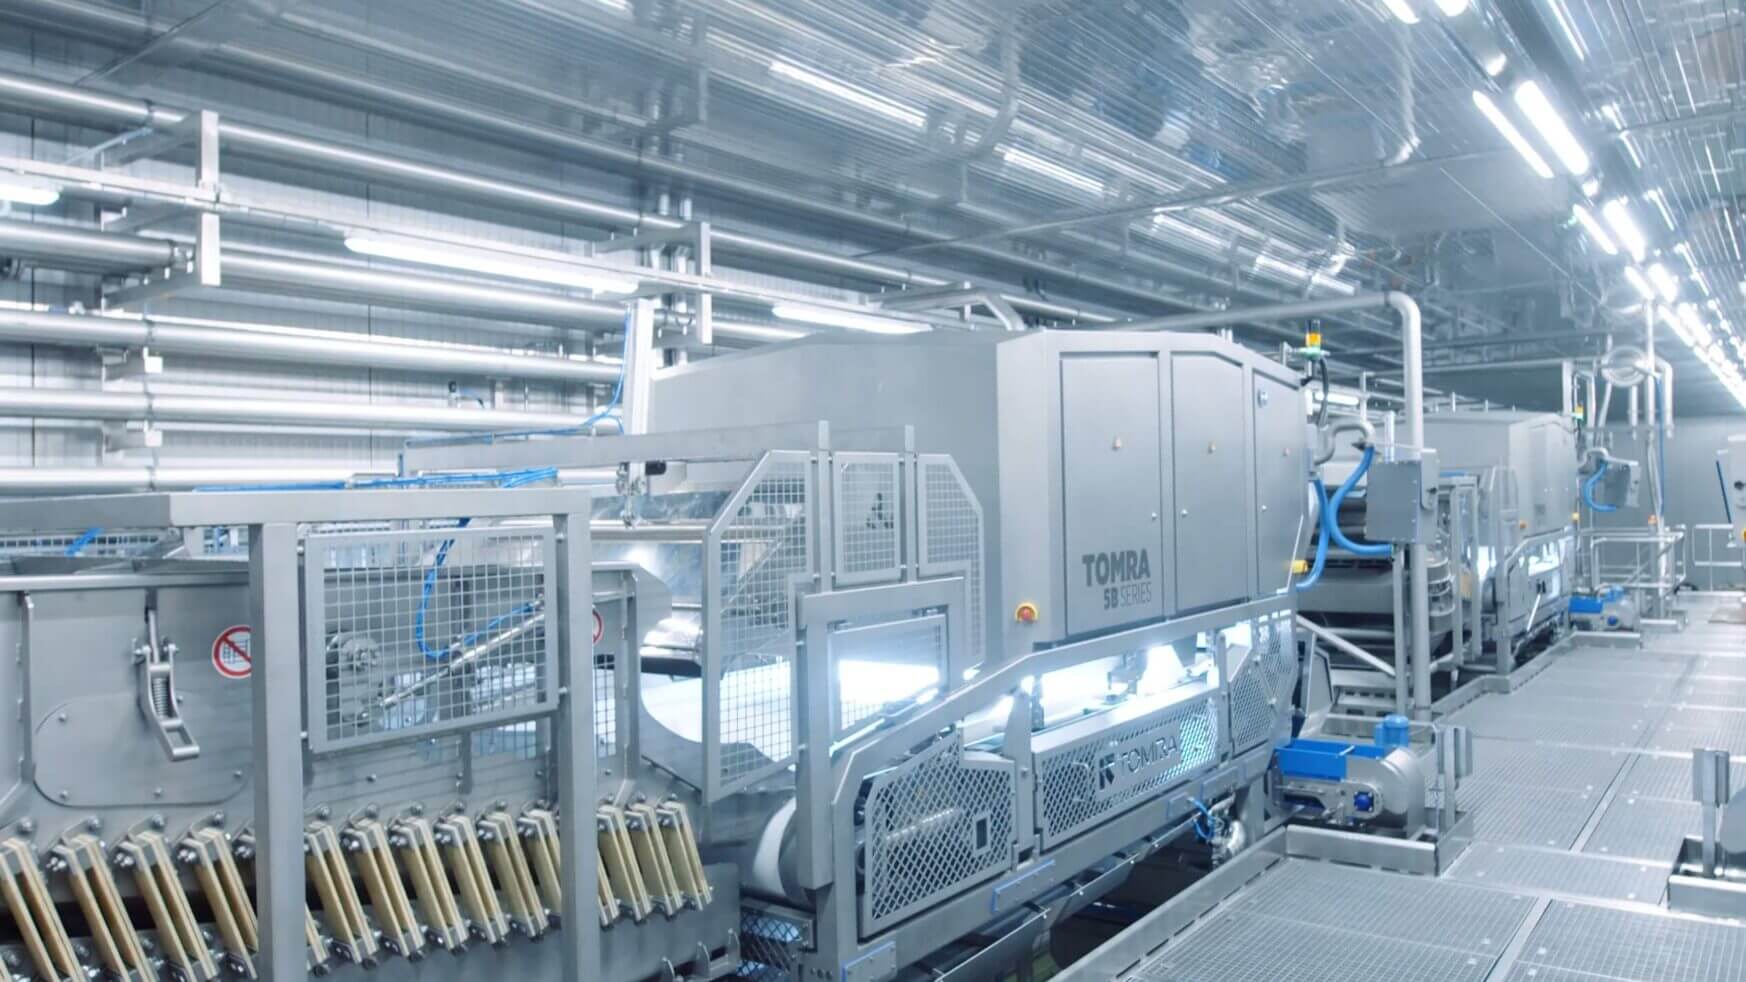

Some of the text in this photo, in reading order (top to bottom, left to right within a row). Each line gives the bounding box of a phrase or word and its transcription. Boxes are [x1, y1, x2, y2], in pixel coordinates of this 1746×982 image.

[1081, 548, 1151, 587] TOMRA
[1104, 581, 1152, 611] 5B SERIES
[1121, 736, 1178, 775] TOMRA
